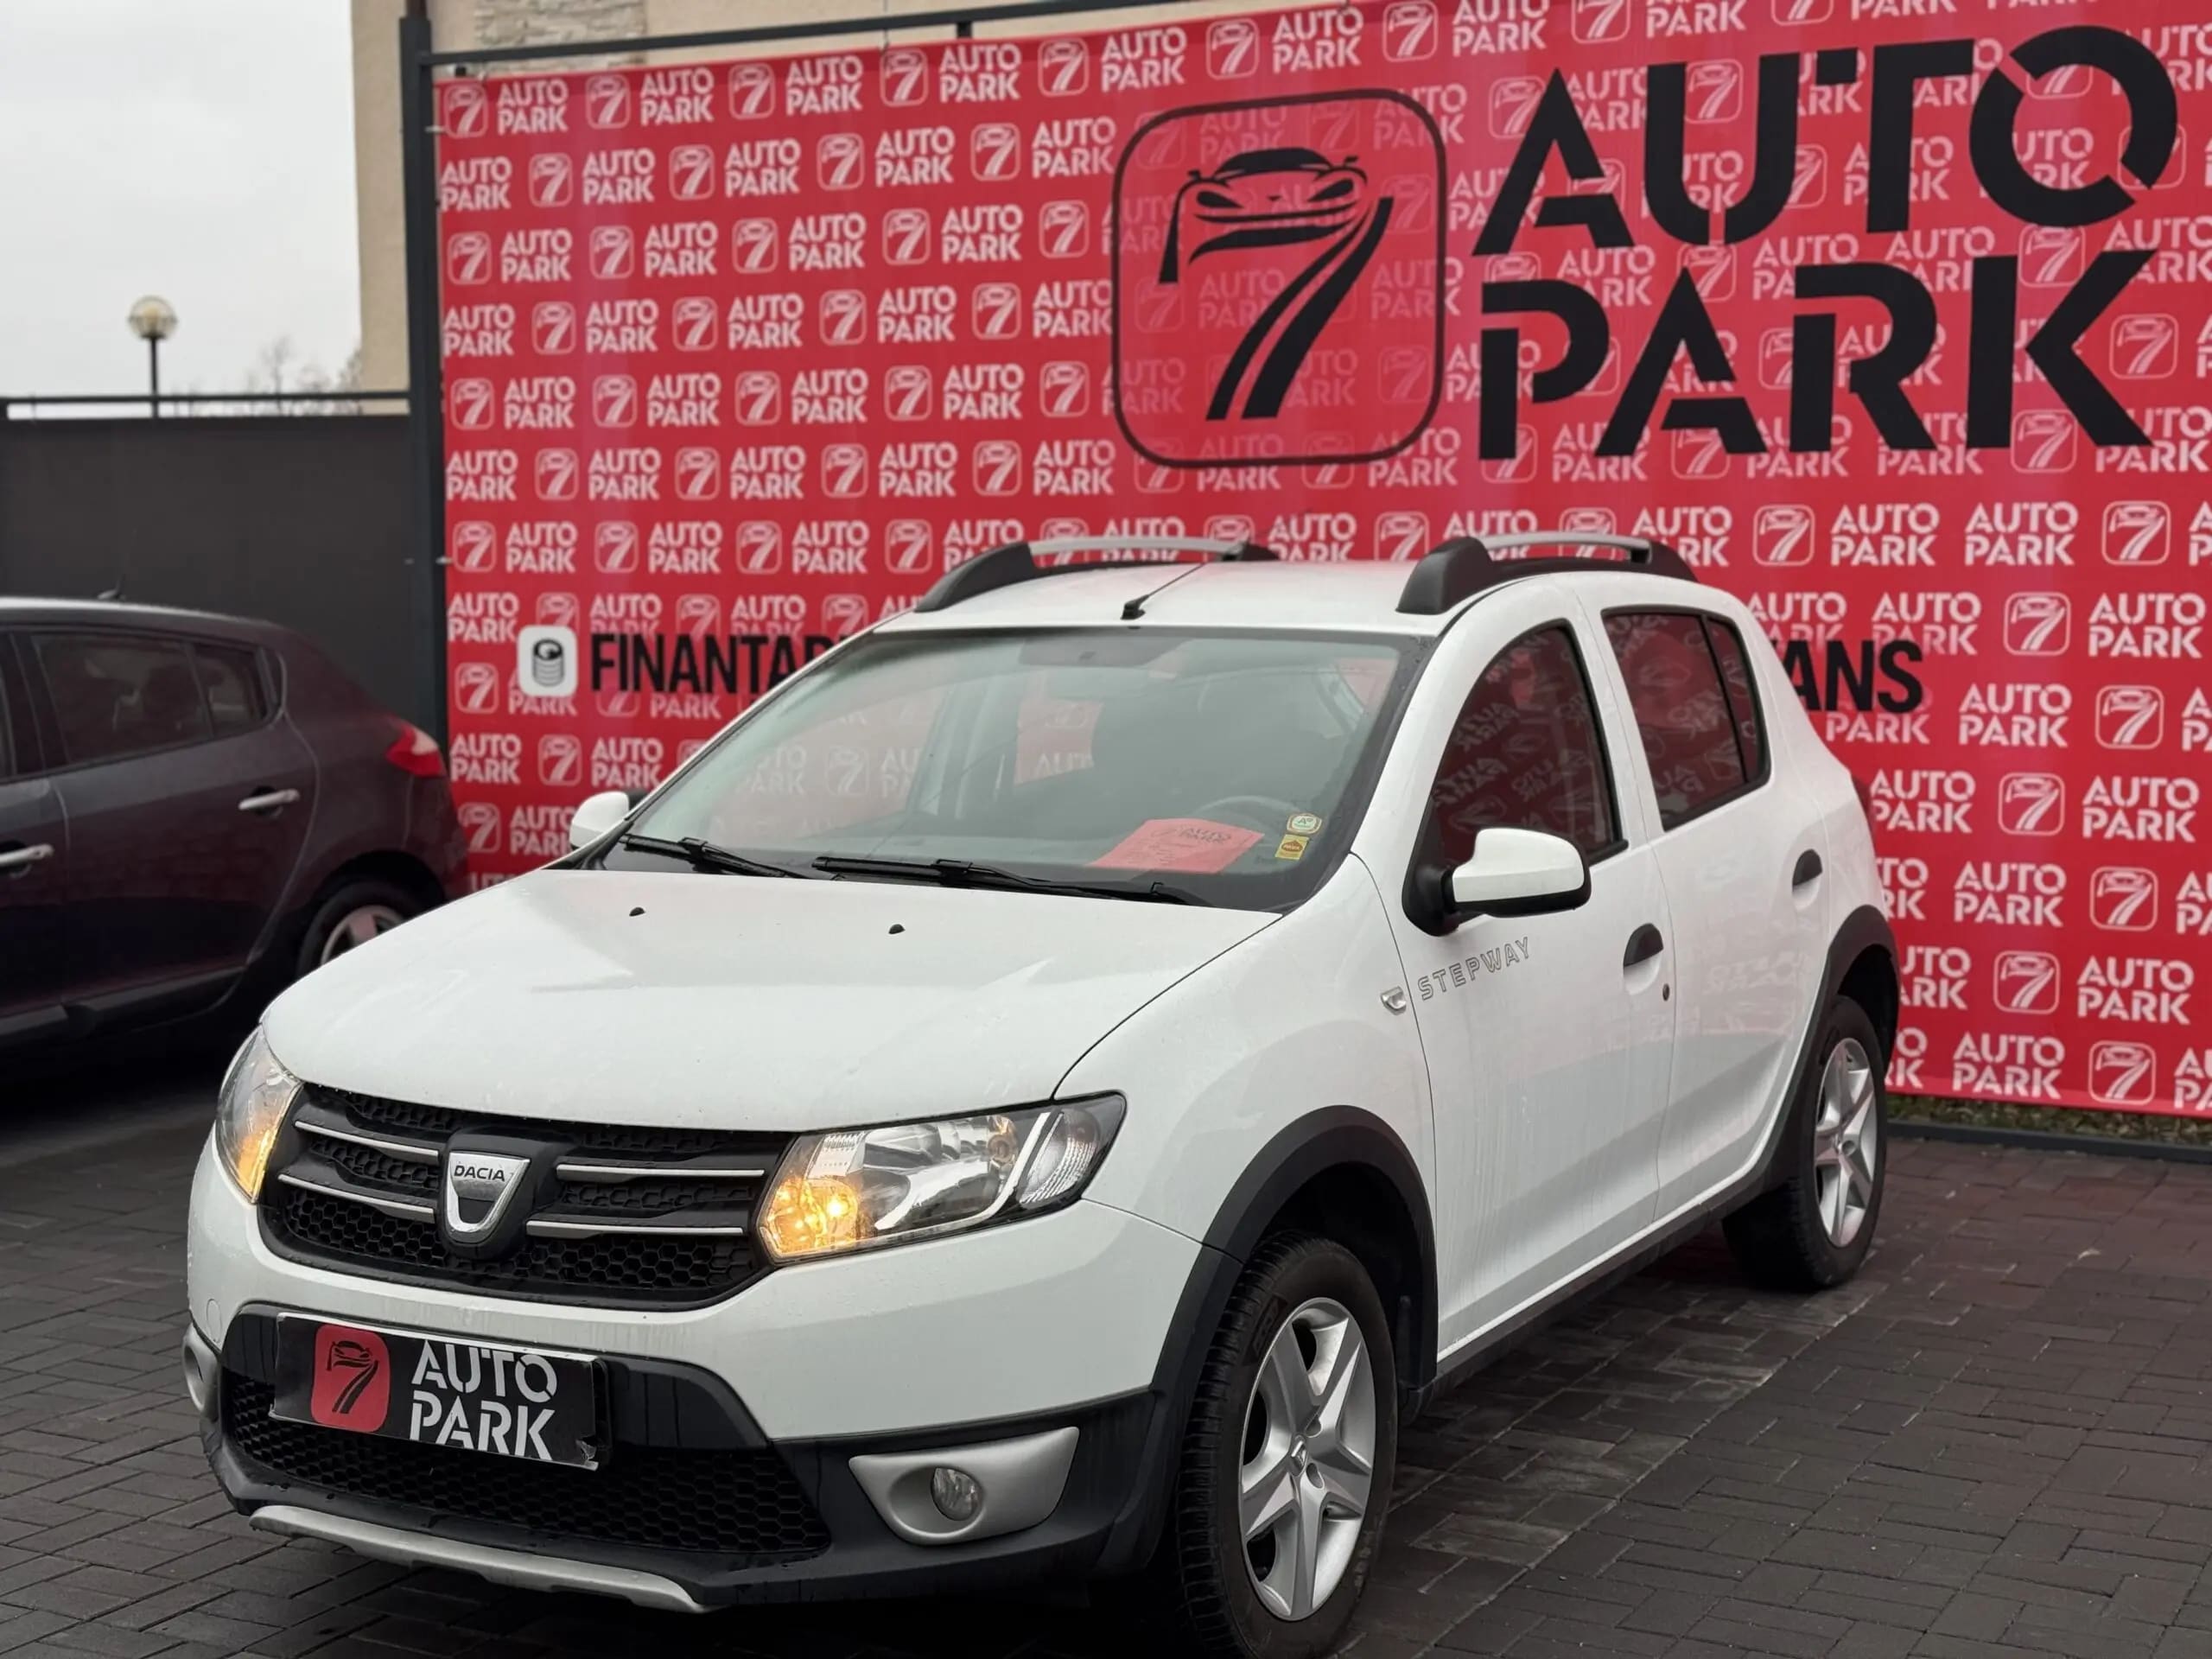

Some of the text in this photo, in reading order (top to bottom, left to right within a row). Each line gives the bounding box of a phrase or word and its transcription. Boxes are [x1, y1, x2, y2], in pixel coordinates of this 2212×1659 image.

[1273, 8, 1364, 42] AUTO
[1645, 1, 1747, 38] PARK
[1101, 27, 1187, 64] AUTO
[1453, 19, 1546, 56] PARK
[939, 43, 1021, 73] AUTO
[1274, 36, 1360, 73] PARK
[640, 67, 714, 99] AUTO
[785, 55, 863, 89] AUTO
[939, 71, 1020, 103] PARK
[1101, 54, 1185, 92] PARK
[497, 79, 568, 109] AUTO
[640, 93, 714, 126] PARK
[785, 81, 862, 116] PARK
[498, 104, 568, 135] PARK
[1032, 116, 1116, 150] AUTO
[724, 138, 801, 170] AUTO
[874, 125, 956, 160] AUTO
[1471, 24, 2178, 257] AUTO
[2012, 127, 2094, 163] UTO
[438, 156, 512, 187] AUTO
[582, 148, 656, 179] AUTO
[875, 154, 953, 188] PARK
[1032, 146, 1114, 179] PARK
[440, 181, 511, 212] PARK
[582, 175, 654, 206] PARK
[725, 165, 799, 198] PARK
[644, 220, 719, 251] AUTO
[789, 212, 867, 245] AUTO
[941, 204, 1024, 236] AUTO
[2103, 216, 2212, 251] AUTO
[500, 228, 573, 257] AUTO
[789, 239, 865, 271] PARK
[942, 231, 1021, 264] PARK
[1753, 233, 1859, 269] AUTO
[1885, 226, 1996, 262] AUTO
[501, 254, 571, 283] PARK
[645, 247, 717, 277] PARK
[1558, 244, 1656, 281] AUTO
[2134, 250, 2212, 283] ARK
[1033, 280, 1112, 311] AUTO
[1198, 268, 1286, 301] AUTO
[1753, 269, 1796, 301] PA
[585, 298, 659, 327] AUTO
[728, 292, 804, 324] AUTO
[877, 285, 957, 316] AUTO
[1198, 301, 1270, 330] PAR
[442, 303, 516, 332] AUTO
[878, 312, 955, 343] PARK
[1033, 308, 1112, 338] PARK
[442, 328, 513, 357] PARK
[585, 324, 658, 353] PARK
[728, 319, 803, 350] PARK
[1299, 348, 1358, 378] UTO
[1478, 247, 2154, 461] PARK
[504, 376, 576, 404] AUTO
[647, 372, 721, 401] AUTO
[791, 367, 868, 398] AUTO
[943, 363, 1025, 393] AUTO
[1284, 378, 1357, 408] ARK
[504, 401, 574, 429] PARK
[647, 398, 720, 427] PARK
[791, 394, 867, 424] PARK
[944, 390, 1021, 420] PARK
[2128, 405, 2212, 440] UTO
[445, 448, 518, 476] AUTO
[588, 447, 661, 475] AUTO
[730, 445, 806, 474] AUTO
[879, 442, 958, 471] AUTO
[1033, 440, 1116, 468] AUTO
[1198, 433, 1285, 461] AUTO
[1746, 445, 1850, 479] PARK
[1877, 443, 1984, 477] PARK
[2095, 438, 2210, 473] PARK
[1033, 467, 1113, 496] PARK
[1196, 464, 1282, 493] PARK
[1368, 458, 1459, 488] PARK
[1552, 451, 1649, 483] PARK
[446, 474, 516, 501] PARK
[588, 473, 659, 500] PARK
[730, 471, 804, 499] PARK
[879, 469, 956, 497] PARK
[791, 519, 869, 548] AUTO
[944, 518, 1024, 546] AUTO
[1268, 512, 1357, 542] AUTO
[1443, 509, 1539, 540] AUTO
[1631, 505, 1732, 537] AUTO
[1830, 502, 1940, 535] AUTO
[1965, 501, 2079, 535] AUTO
[505, 521, 578, 548] AUTO
[648, 521, 723, 549] AUTO
[1830, 534, 1936, 566] PARK
[1964, 533, 2075, 566] PARK
[505, 545, 575, 573] PARK
[648, 546, 720, 574] PARK
[792, 545, 867, 574] PARK
[448, 592, 519, 618] AUTO
[589, 593, 663, 620] AUTO
[730, 594, 807, 621] AUTO
[1747, 592, 1847, 622] AUTO
[1872, 592, 1981, 623] AUTO
[2088, 593, 2206, 626] AUTO
[447, 616, 518, 643] PARK
[2088, 625, 2202, 658] PARK
[1771, 639, 1923, 714] ANS
[507, 691, 578, 717] PARK
[650, 693, 722, 720] PARK
[1959, 683, 2072, 715] AUTO
[1825, 711, 1931, 745] PARK
[1959, 714, 2068, 747] PARK
[450, 734, 521, 759] AUTO
[592, 738, 664, 764] AUTO
[451, 757, 518, 783] PARK
[591, 761, 663, 789] PARK
[1870, 768, 1977, 802] AUTO
[2082, 776, 2200, 810] AUTO
[1872, 800, 1973, 834] PARK
[2082, 806, 2196, 842] PARK
[1954, 861, 2067, 895] AUTO
[1955, 891, 2063, 927] PARK
[1417, 936, 1530, 1001] STEPWAY
[2077, 957, 2194, 992] AUTO
[2077, 986, 2190, 1025] PARK
[1953, 1033, 2065, 1067] AUTO
[1952, 1062, 2061, 1100] PARK
[454, 1165, 505, 1182] DACIA
[410, 1338, 558, 1404] AUTO
[409, 1389, 556, 1461] PARK
